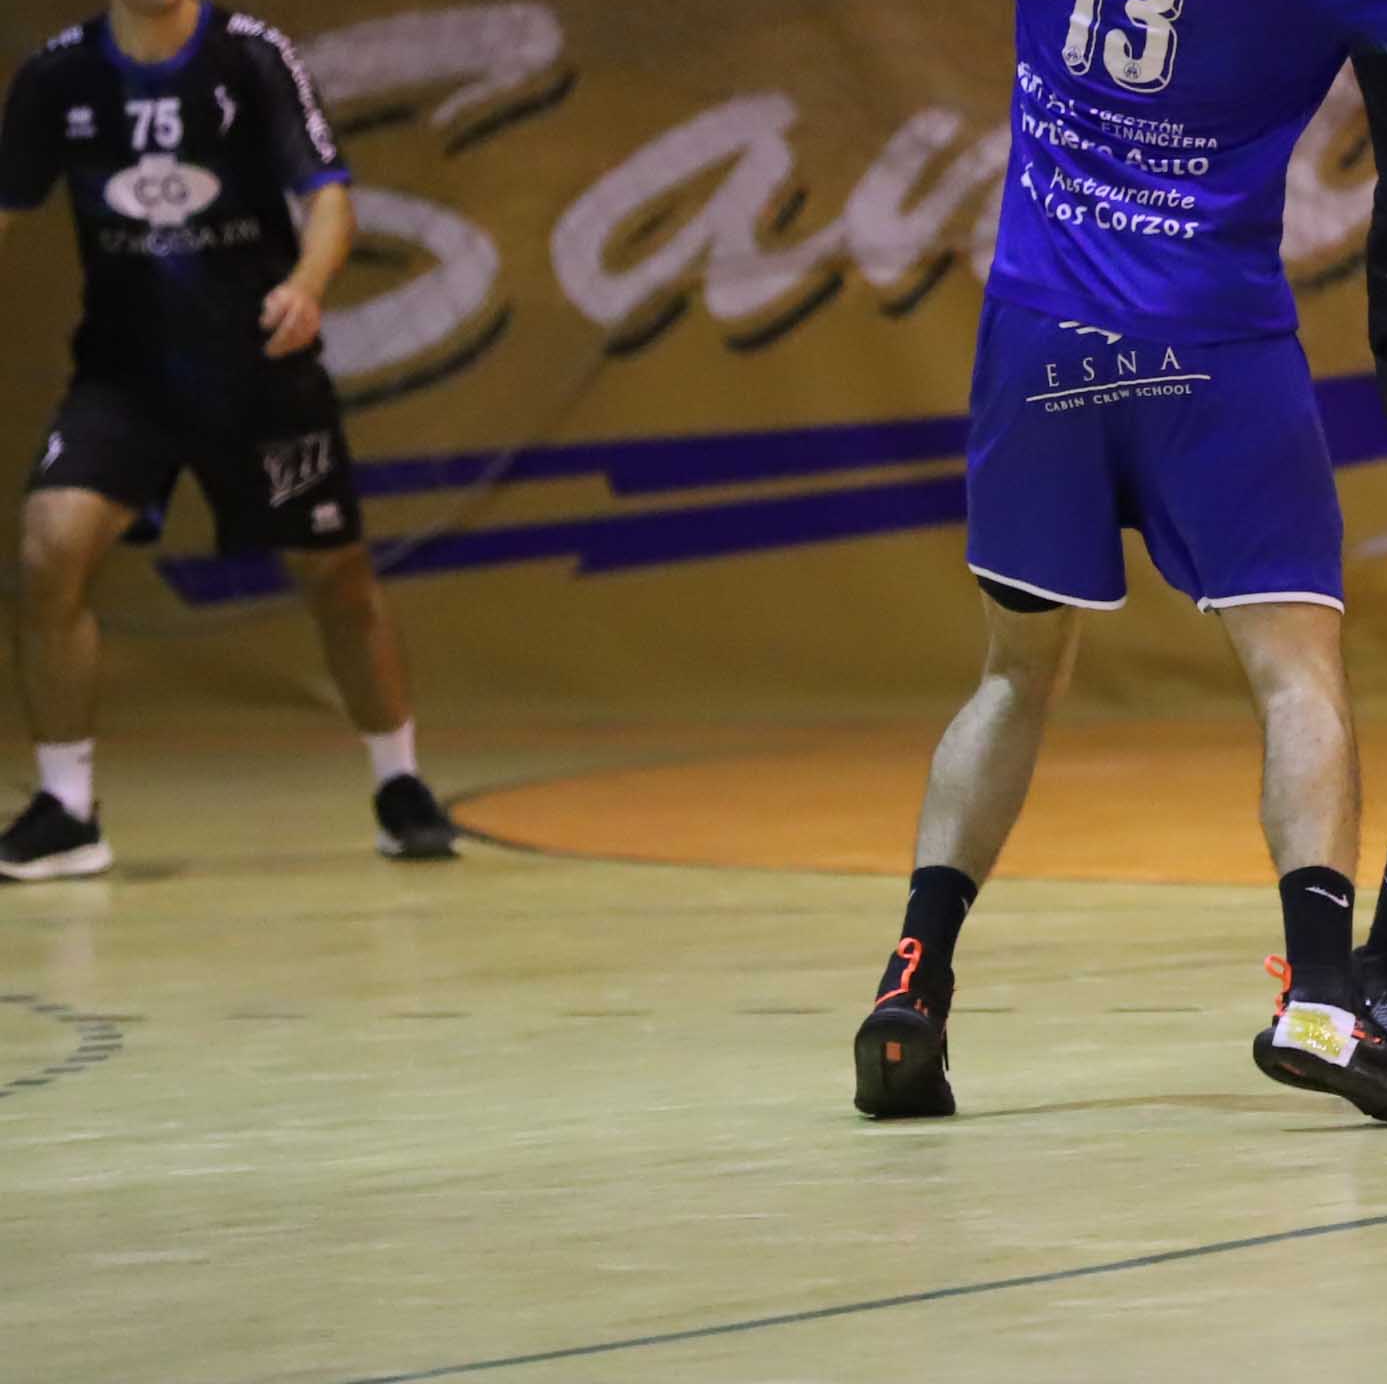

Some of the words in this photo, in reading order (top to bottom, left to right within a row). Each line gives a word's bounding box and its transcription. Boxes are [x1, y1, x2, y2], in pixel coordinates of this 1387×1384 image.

[124, 97, 183, 150] 75
[1100, 122, 1219, 150] FINANCIERA
[1095, 201, 1200, 240] Corzos
[1045, 345, 1182, 388] ESNA
[1045, 397, 1086, 413] CABIN
[1093, 388, 1131, 405] CREW
[1135, 383, 1193, 398] SCHOOL
